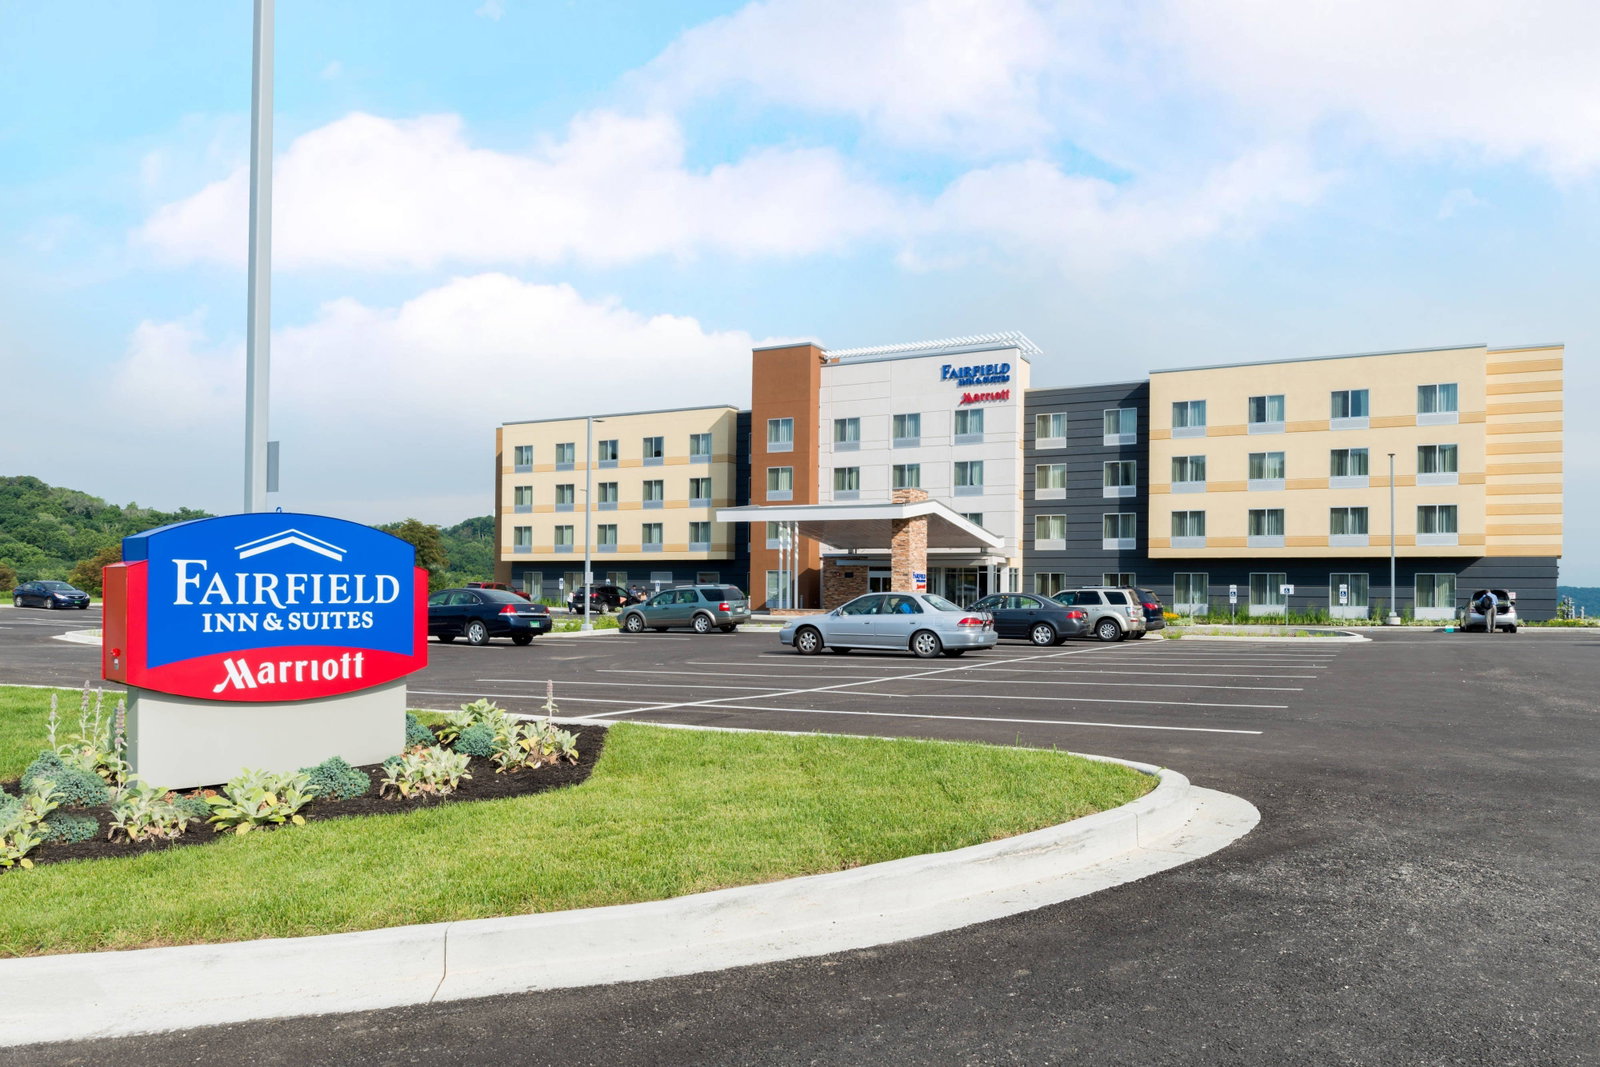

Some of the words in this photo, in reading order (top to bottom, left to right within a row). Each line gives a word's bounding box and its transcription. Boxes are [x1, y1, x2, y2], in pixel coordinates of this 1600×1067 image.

[941, 362, 1011, 379] FAIRFIELD
[960, 389, 1010, 404] Marriott
[171, 558, 400, 609] FAIRFIELD
[202, 612, 259, 632] INN
[263, 613, 284, 631] &
[288, 611, 374, 631] SUITES
[212, 652, 364, 693] Marriott
